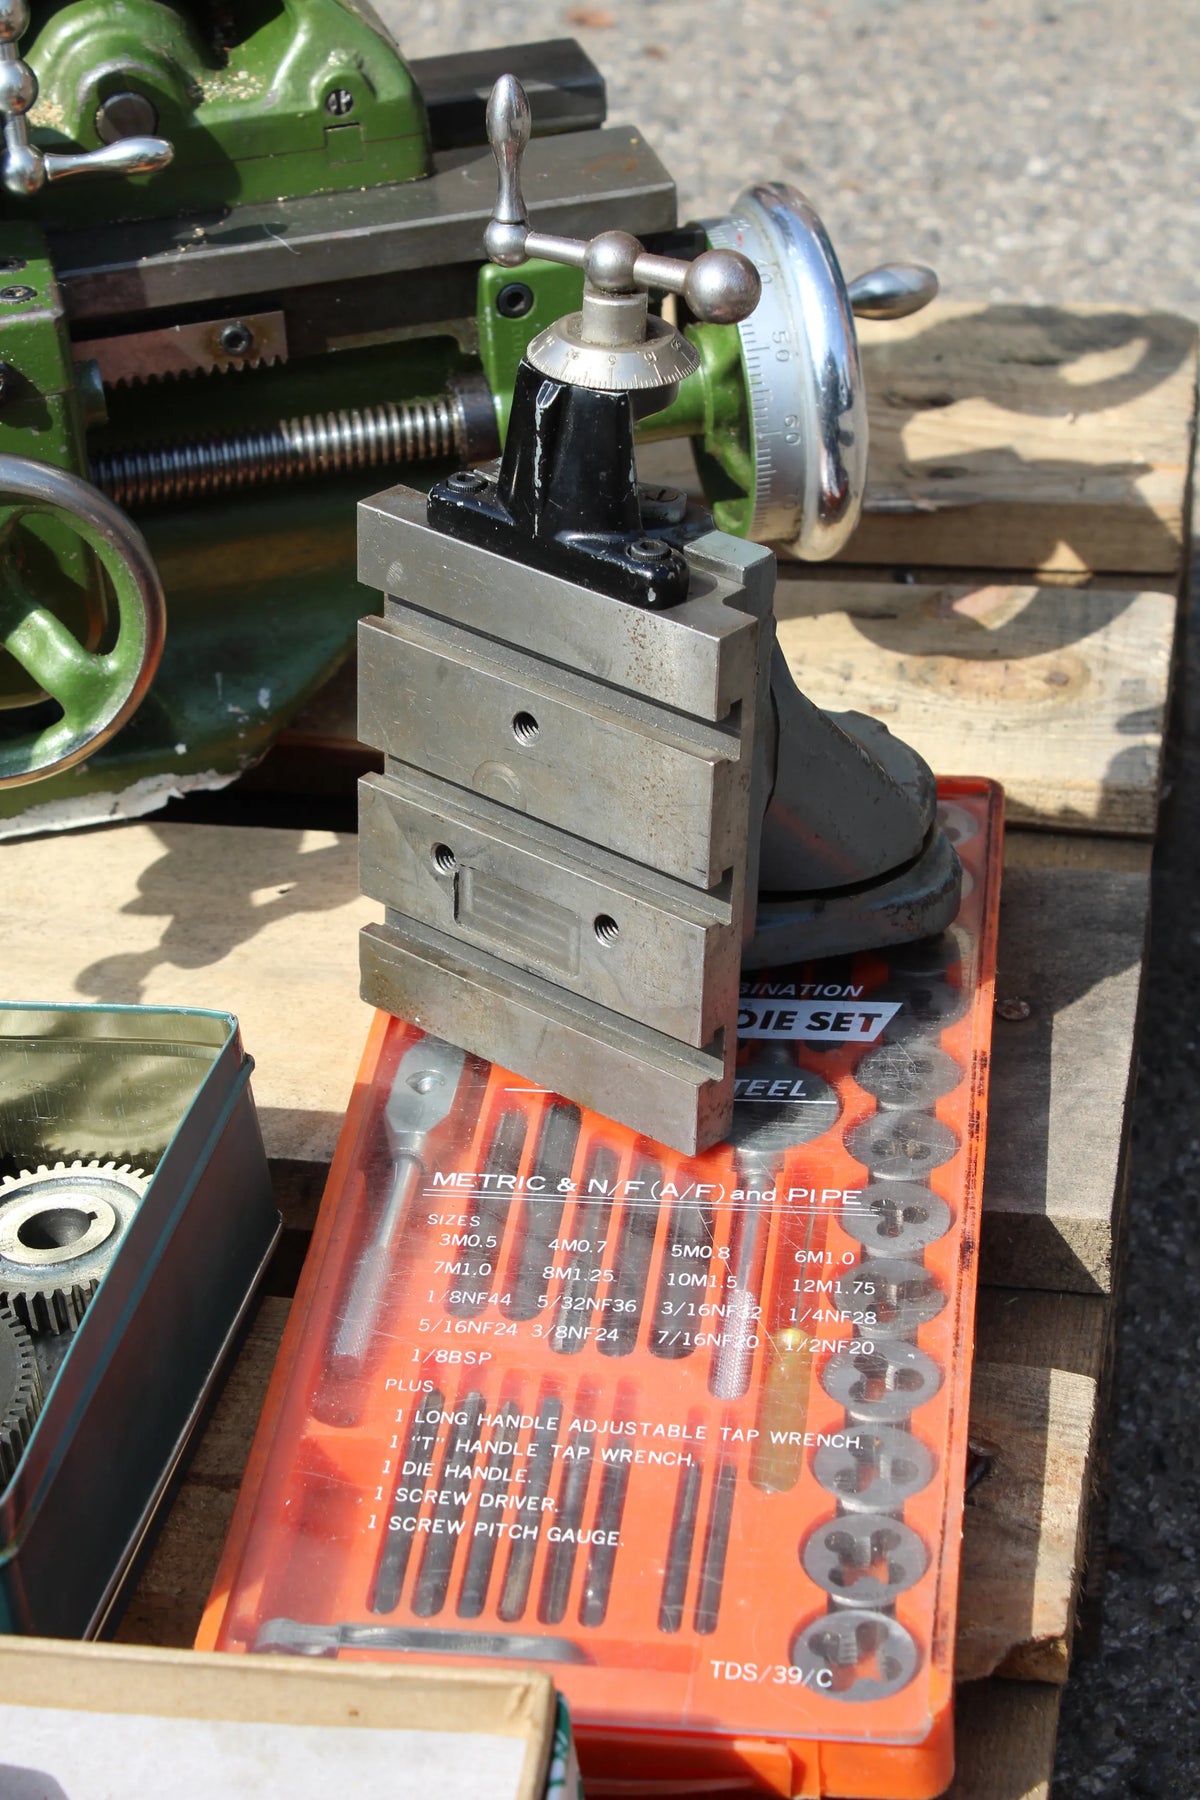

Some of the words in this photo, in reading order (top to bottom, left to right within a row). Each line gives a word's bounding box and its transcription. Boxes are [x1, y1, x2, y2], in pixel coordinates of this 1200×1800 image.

[771, 330, 791, 363] 50
[784, 414, 801, 446] 60
[805, 1012, 883, 1033] SET
[433, 1172, 546, 1192] METRIC
[556, 1177, 577, 1193] &
[587, 1179, 647, 1195] N/F
[650, 1181, 726, 1203] (A/F)
[730, 1186, 777, 1202] and
[787, 1188, 863, 1205] PIPE
[427, 1213, 481, 1227] SIZES
[438, 1233, 497, 1248] 3M0.5
[548, 1239, 608, 1253] 4M0.7
[671, 1244, 731, 1259] 5M0.8
[794, 1250, 855, 1265] 6M1.0
[433, 1261, 492, 1276] 7M1.0
[667, 1273, 738, 1289] 10M1.5
[792, 1279, 876, 1295] 12M1.75
[427, 1290, 512, 1306] 1/8NF44
[537, 1295, 637, 1312] 5/32NF36
[661, 1301, 762, 1320] 3/16NF32
[789, 1307, 877, 1325] 1/4NF28
[418, 1318, 518, 1336] 5/16NF24
[530, 1324, 620, 1342] 3/8NF24
[785, 1338, 875, 1355] 1/2NF20
[411, 1348, 492, 1365] 1/8BSP
[384, 1378, 434, 1393] PLUS
[395, 1409, 403, 1422] 1
[414, 1410, 468, 1426] LONG
[477, 1413, 560, 1431] HANDLE
[568, 1419, 708, 1440] ADJUSTABLE
[719, 1427, 760, 1442] TAP
[770, 1431, 865, 1450] WRENCH.
[390, 1435, 399, 1449] 1
[455, 1439, 539, 1457] HANDLE
[551, 1444, 592, 1460] TAP
[601, 1447, 696, 1467] WRENCH.
[382, 1460, 391, 1474] 1
[401, 1460, 434, 1477] DIE
[444, 1464, 533, 1484] HANDLE.
[374, 1487, 383, 1500] 1
[395, 1487, 472, 1506] SCREW
[479, 1493, 559, 1513] DRIVER.
[367, 1515, 377, 1529] 1
[388, 1516, 466, 1535] SCREW
[473, 1522, 538, 1541] PITCH
[547, 1527, 625, 1547] GAUGE.
[710, 1660, 833, 1688] TDS/39/C
